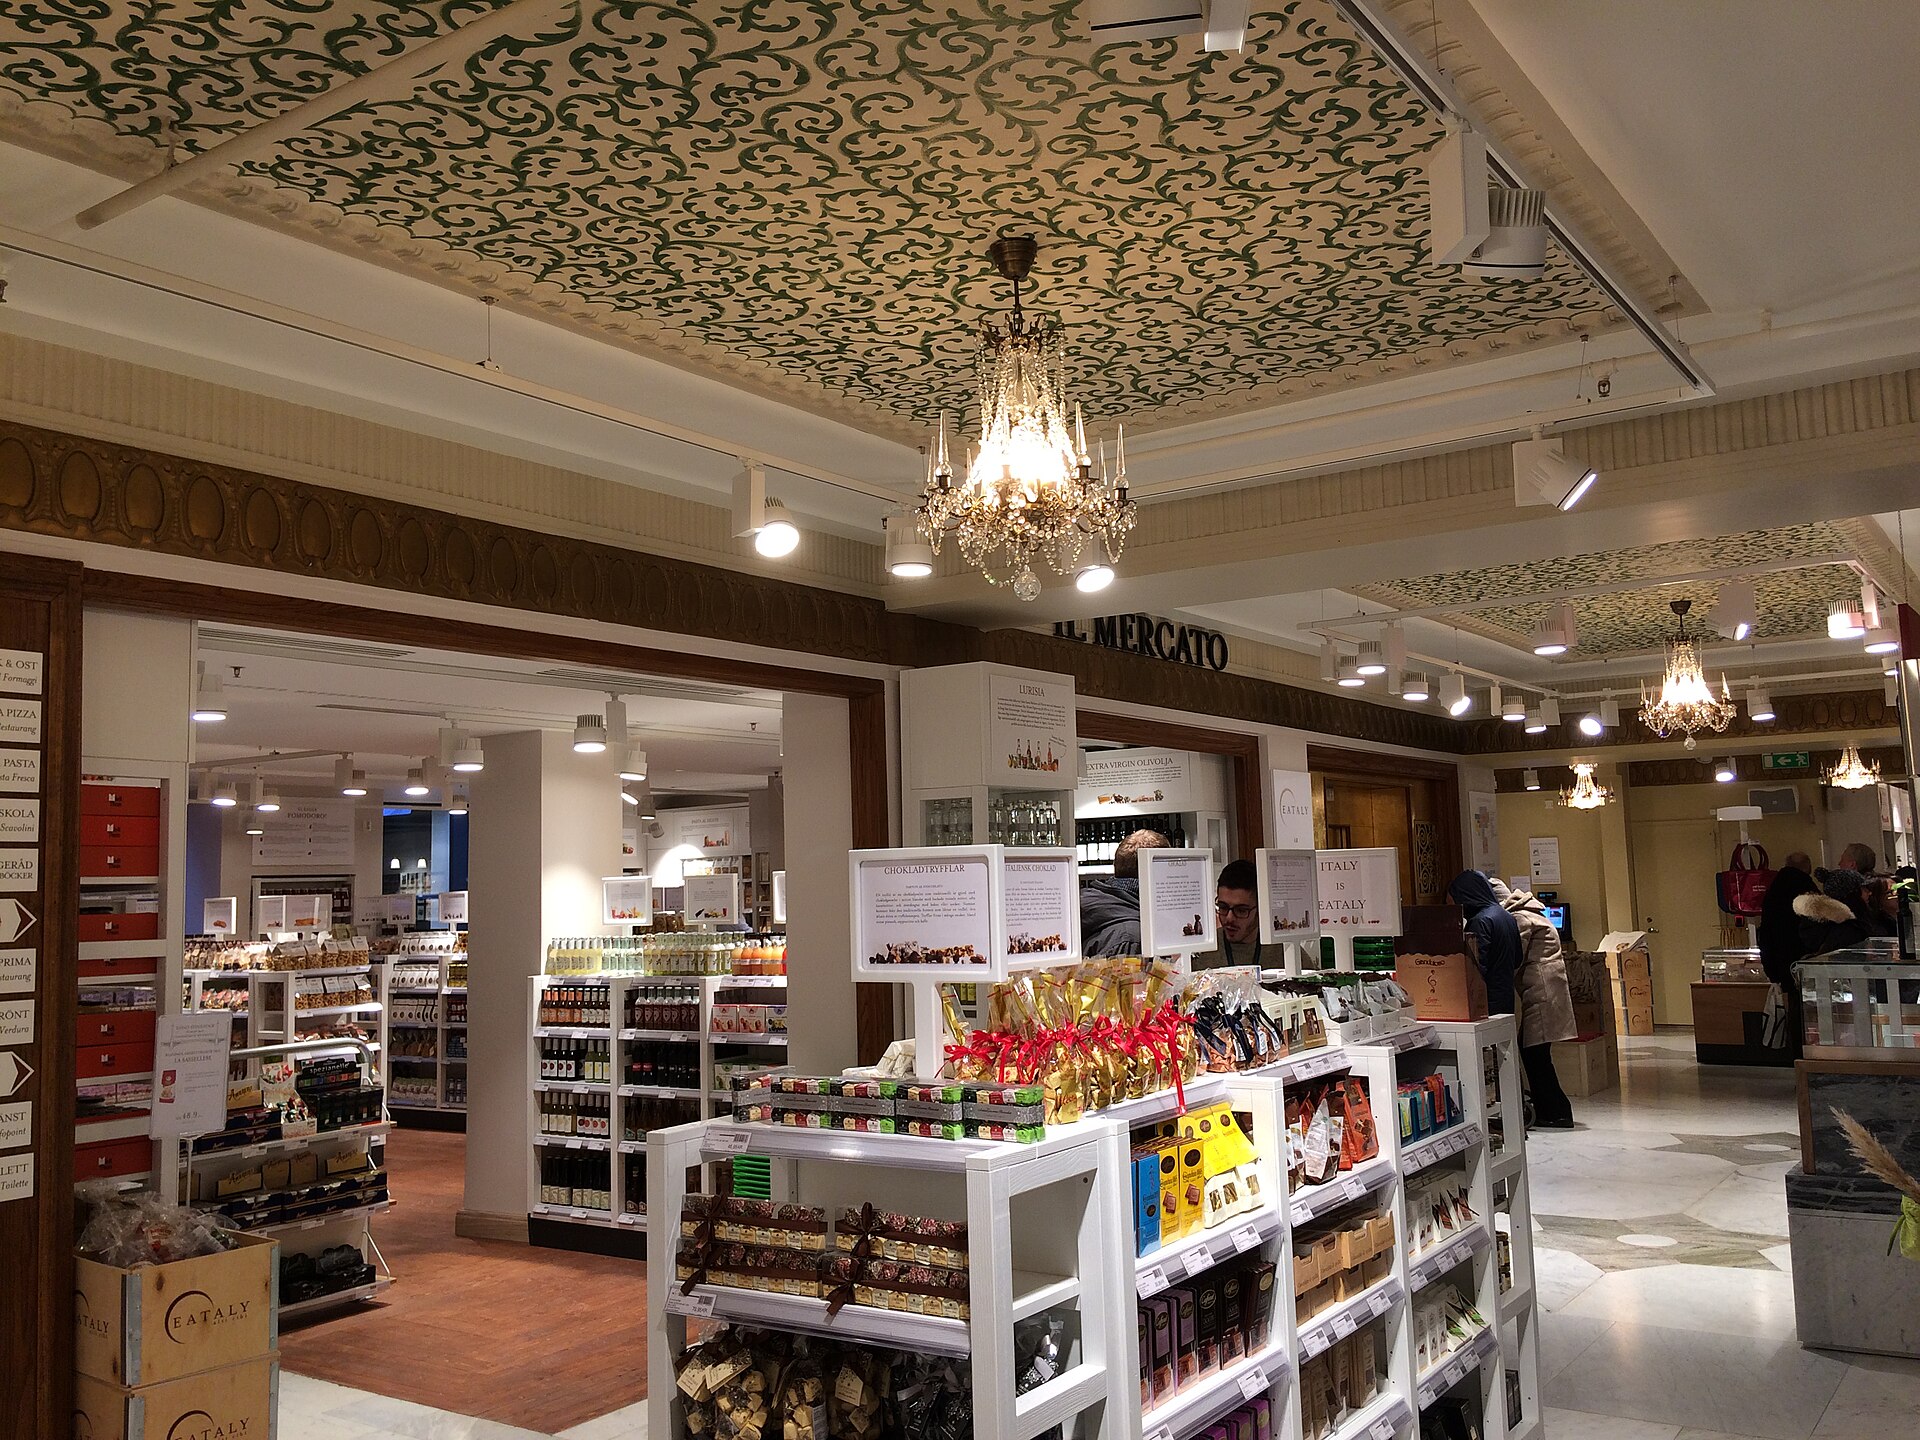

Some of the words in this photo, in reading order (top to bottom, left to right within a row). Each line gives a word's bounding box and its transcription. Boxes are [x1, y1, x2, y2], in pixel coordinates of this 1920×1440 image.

[1093, 612, 1229, 671] MERCATO
[16, 660, 38, 670] OST
[3, 673, 38, 686] Formaggi
[1019, 685, 1045, 697] LURISIA
[7, 708, 37, 719] PIZZA
[0, 723, 37, 735] estaurang
[4, 758, 36, 768] PASTA
[1110, 760, 1136, 769] VIRGIN
[1137, 757, 1174, 767] OLIVOLJA
[12, 773, 35, 782] Fresca
[0, 808, 35, 818] SKOLA
[1282, 805, 1308, 815] EATALY
[0, 823, 35, 832] Scavolini
[884, 864, 966, 875] CHOKLADTRYFFLAR
[1005, 864, 1031, 872] ITALIENSK
[1032, 864, 1057, 872] CHOKLAD
[1320, 860, 1359, 871] ITALY
[1336, 882, 1345, 891] IS
[1318, 899, 1367, 910] EATALY
[0, 957, 32, 967] PRIMA
[0, 1024, 30, 1034] Verdura
[1, 1163, 29, 1175] LETT
[1, 1179, 29, 1190] Toilette
[173, 1301, 250, 1329] EATALY
